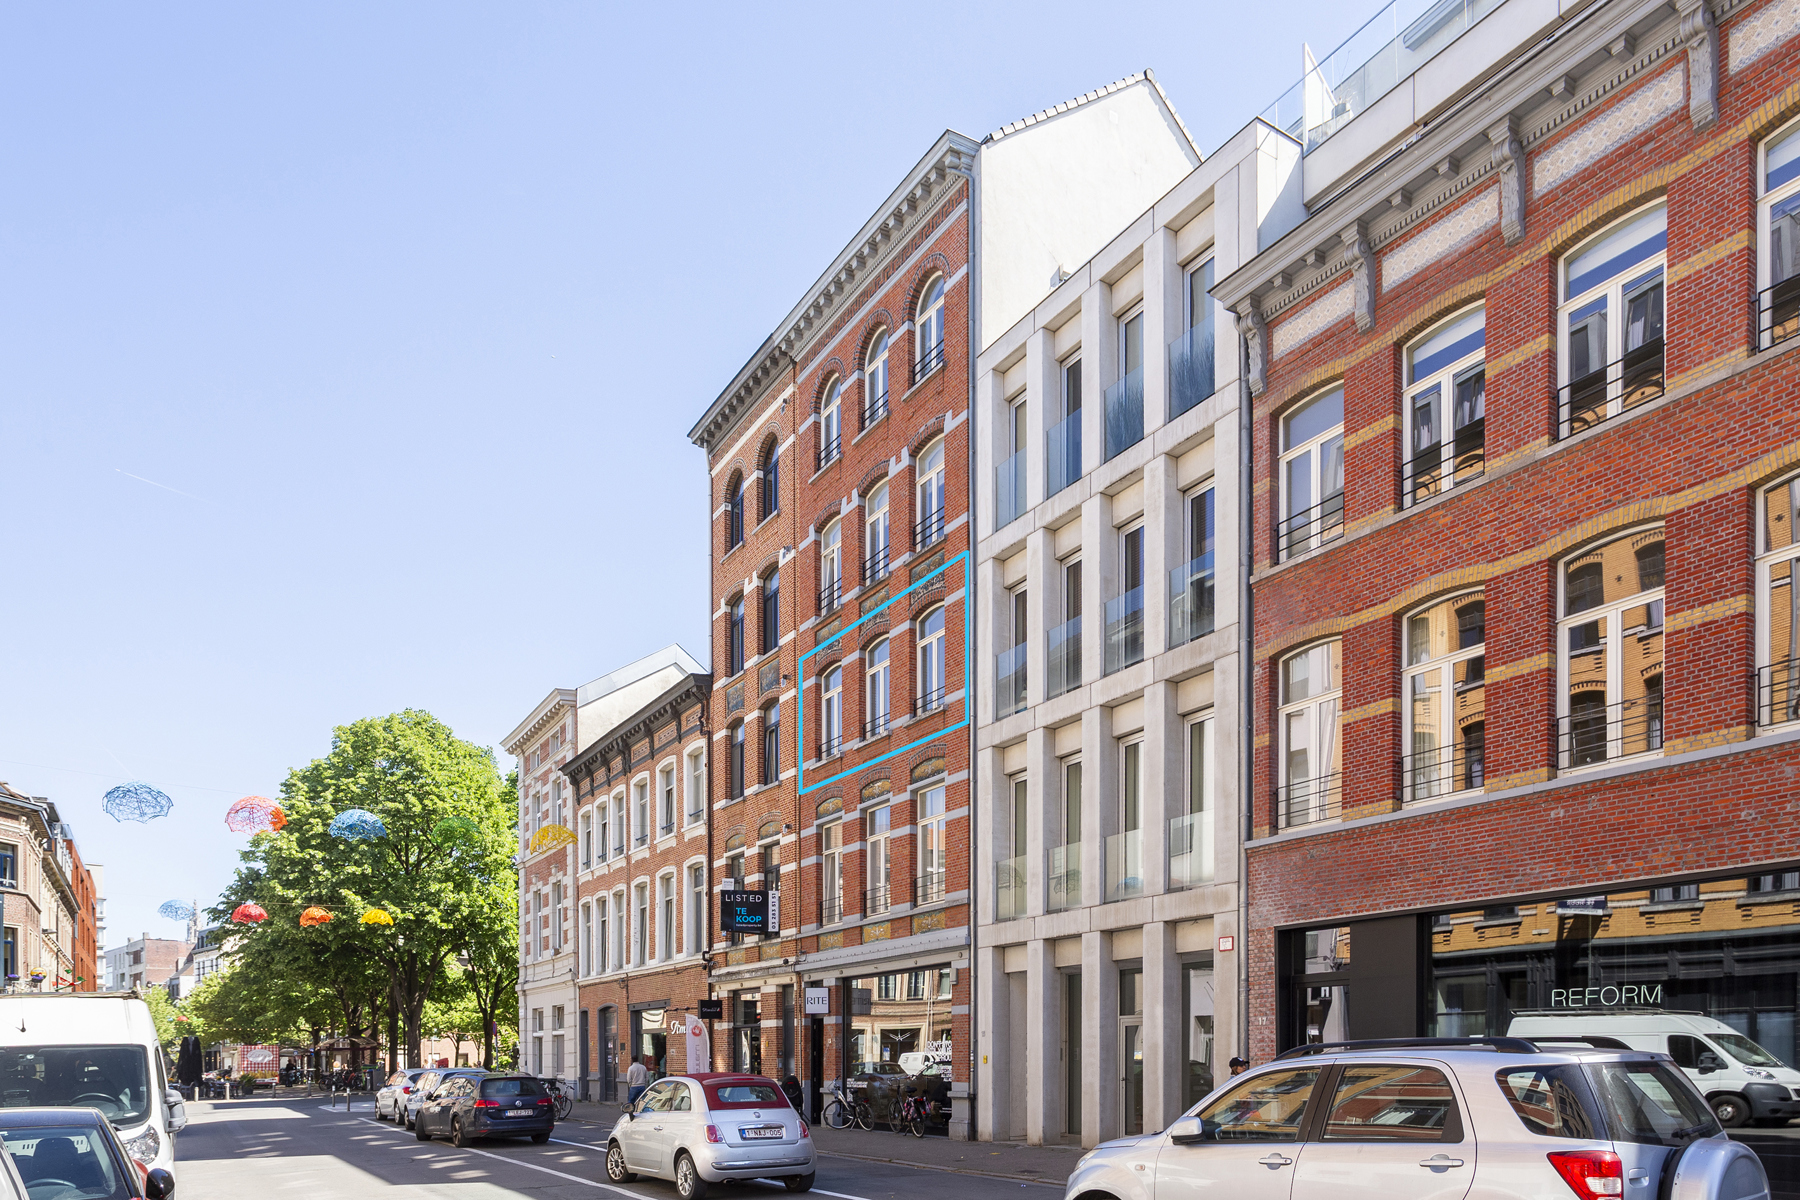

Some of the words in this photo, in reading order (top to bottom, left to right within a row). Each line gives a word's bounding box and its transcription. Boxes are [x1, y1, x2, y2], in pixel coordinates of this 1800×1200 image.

[725, 894, 762, 902] LISTED
[735, 907, 747, 915] TE
[735, 915, 762, 923] KOOP
[772, 922, 776, 930] 03
[1551, 984, 1661, 1007] REFORM
[806, 996, 828, 1005] RITE
[1258, 1017, 1267, 1026] 17
